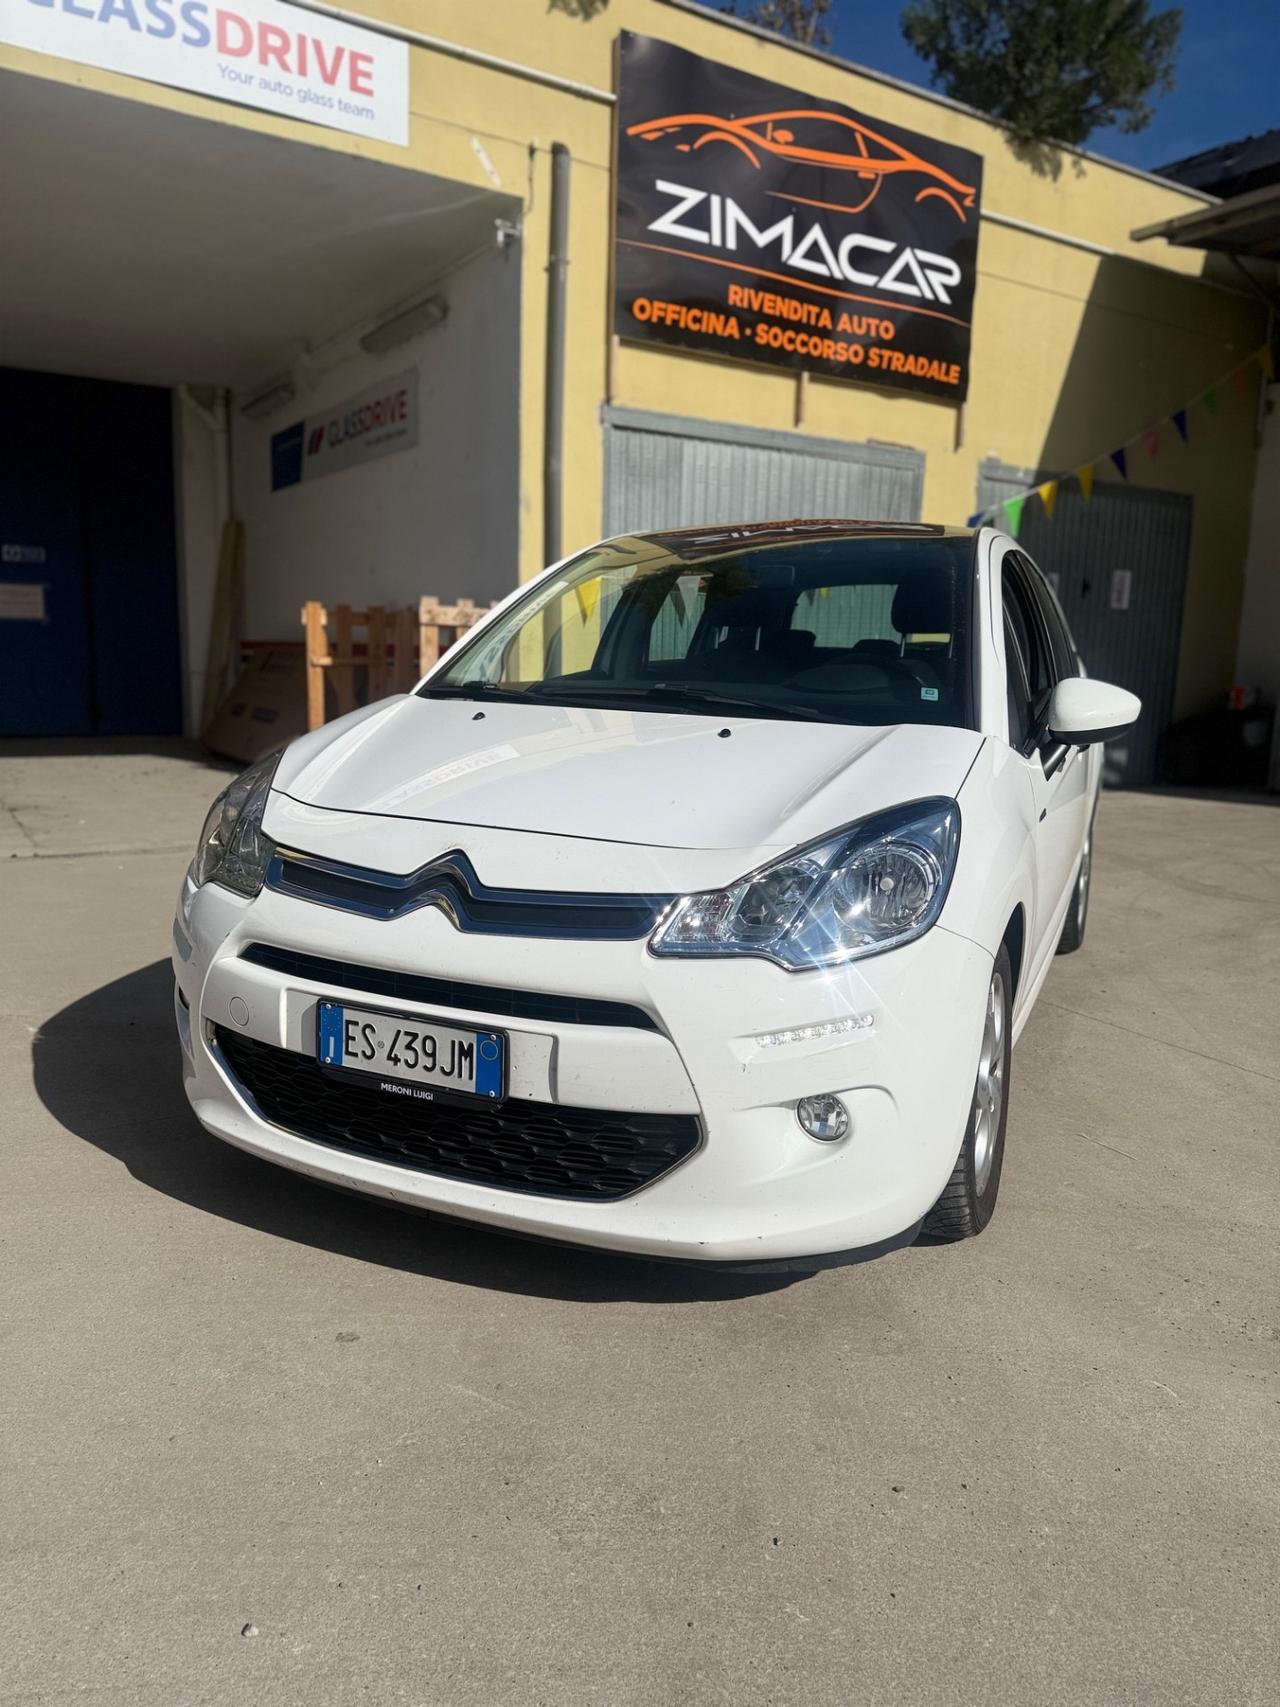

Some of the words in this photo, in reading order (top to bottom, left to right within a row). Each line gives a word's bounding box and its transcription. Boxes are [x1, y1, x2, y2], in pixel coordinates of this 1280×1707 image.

[218, 63, 254, 85] Your
[258, 77, 293, 97] auto
[296, 88, 334, 109] glass
[338, 99, 375, 120] team
[647, 179, 961, 304] ZIMACAR
[632, 298, 740, 339] OFFICINA
[755, 324, 864, 364] SOCCORSO
[868, 350, 961, 384] STRADALE
[728, 284, 832, 329] RIVENDITA
[838, 317, 895, 341] AUTO
[344, 1019, 376, 1060] ES
[380, 1082, 412, 1096] MERONI
[413, 1089, 434, 1101] LUIGI
